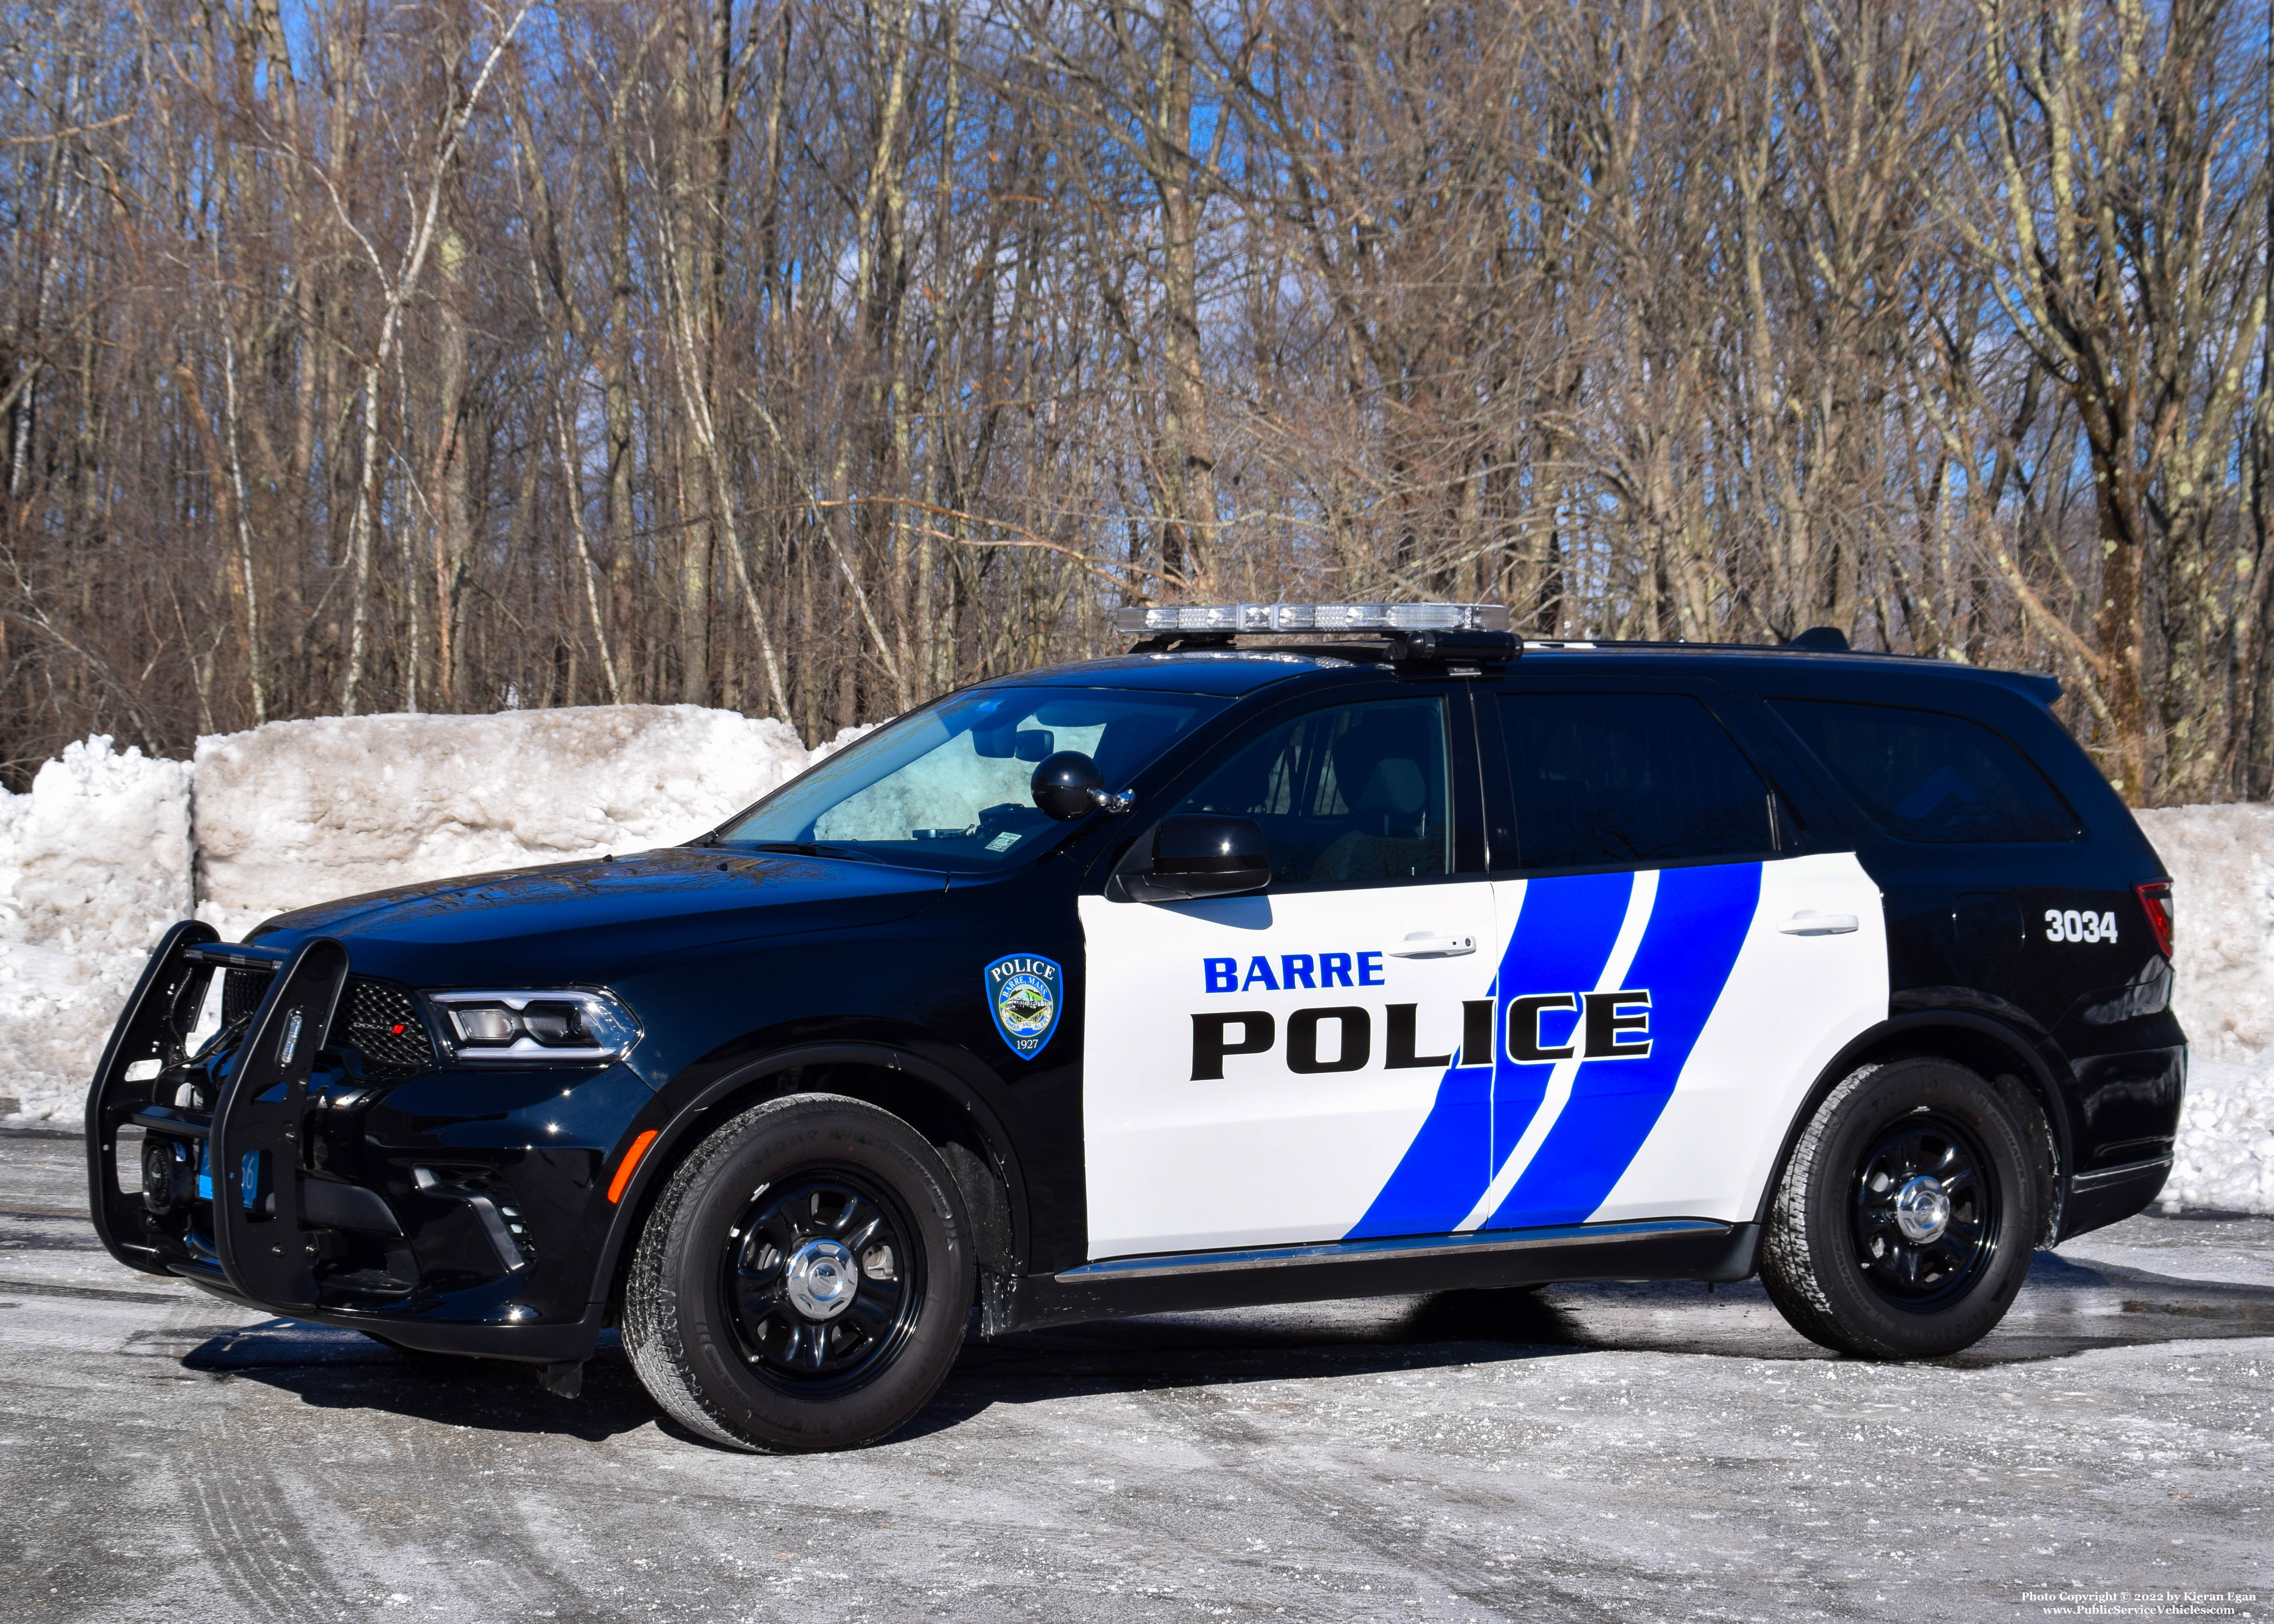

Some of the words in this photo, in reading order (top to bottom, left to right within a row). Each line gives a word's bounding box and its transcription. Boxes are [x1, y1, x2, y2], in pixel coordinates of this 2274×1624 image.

[2045, 909, 2118, 943] 3034
[991, 959, 1055, 982] POLICE
[1203, 951, 1385, 993] BARRE
[1002, 976, 1026, 998] BARRE,
[1028, 976, 1047, 997] MASS.
[1004, 1016, 1021, 1030] TRANQUIL
[1034, 1016, 1049, 1029] ALERT
[1017, 1039, 1038, 1049] 1927
[1190, 991, 1652, 1081] POLICE
[932, 1187, 948, 1212] PURSUIT
